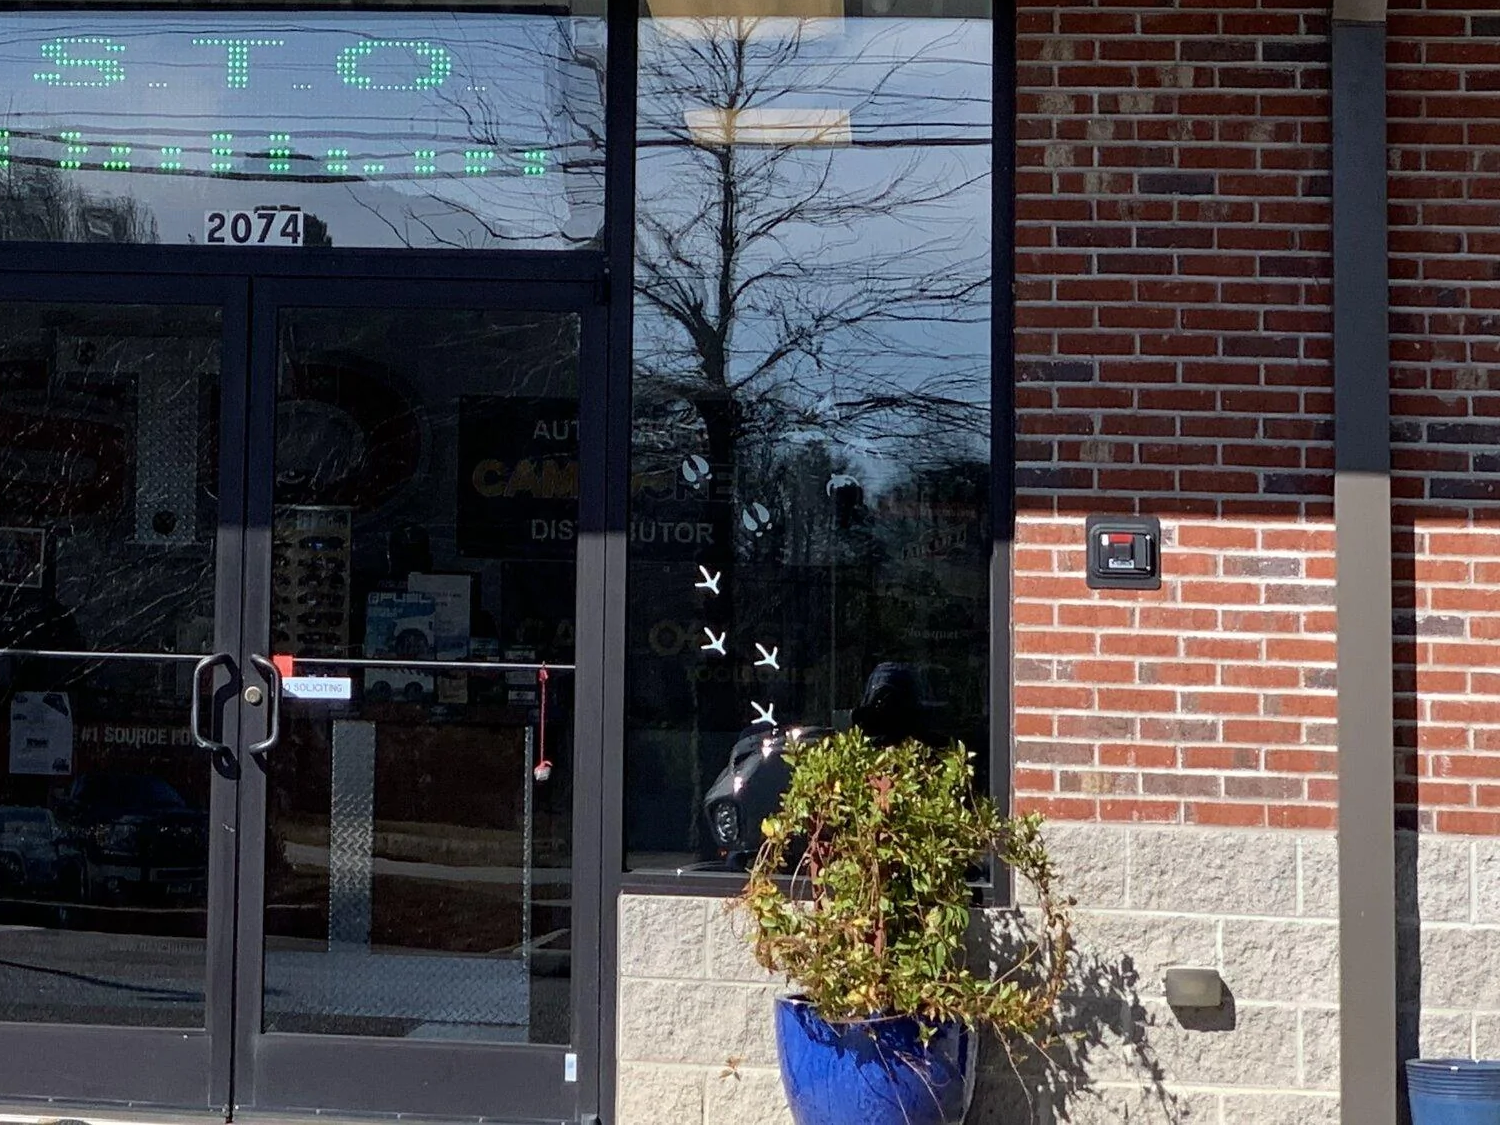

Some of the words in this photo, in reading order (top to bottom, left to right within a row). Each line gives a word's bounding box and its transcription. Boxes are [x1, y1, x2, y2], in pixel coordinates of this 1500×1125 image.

[206, 212, 301, 244] 2074
[294, 683, 343, 692] SOLICITING
[103, 724, 167, 745] SOURCE
